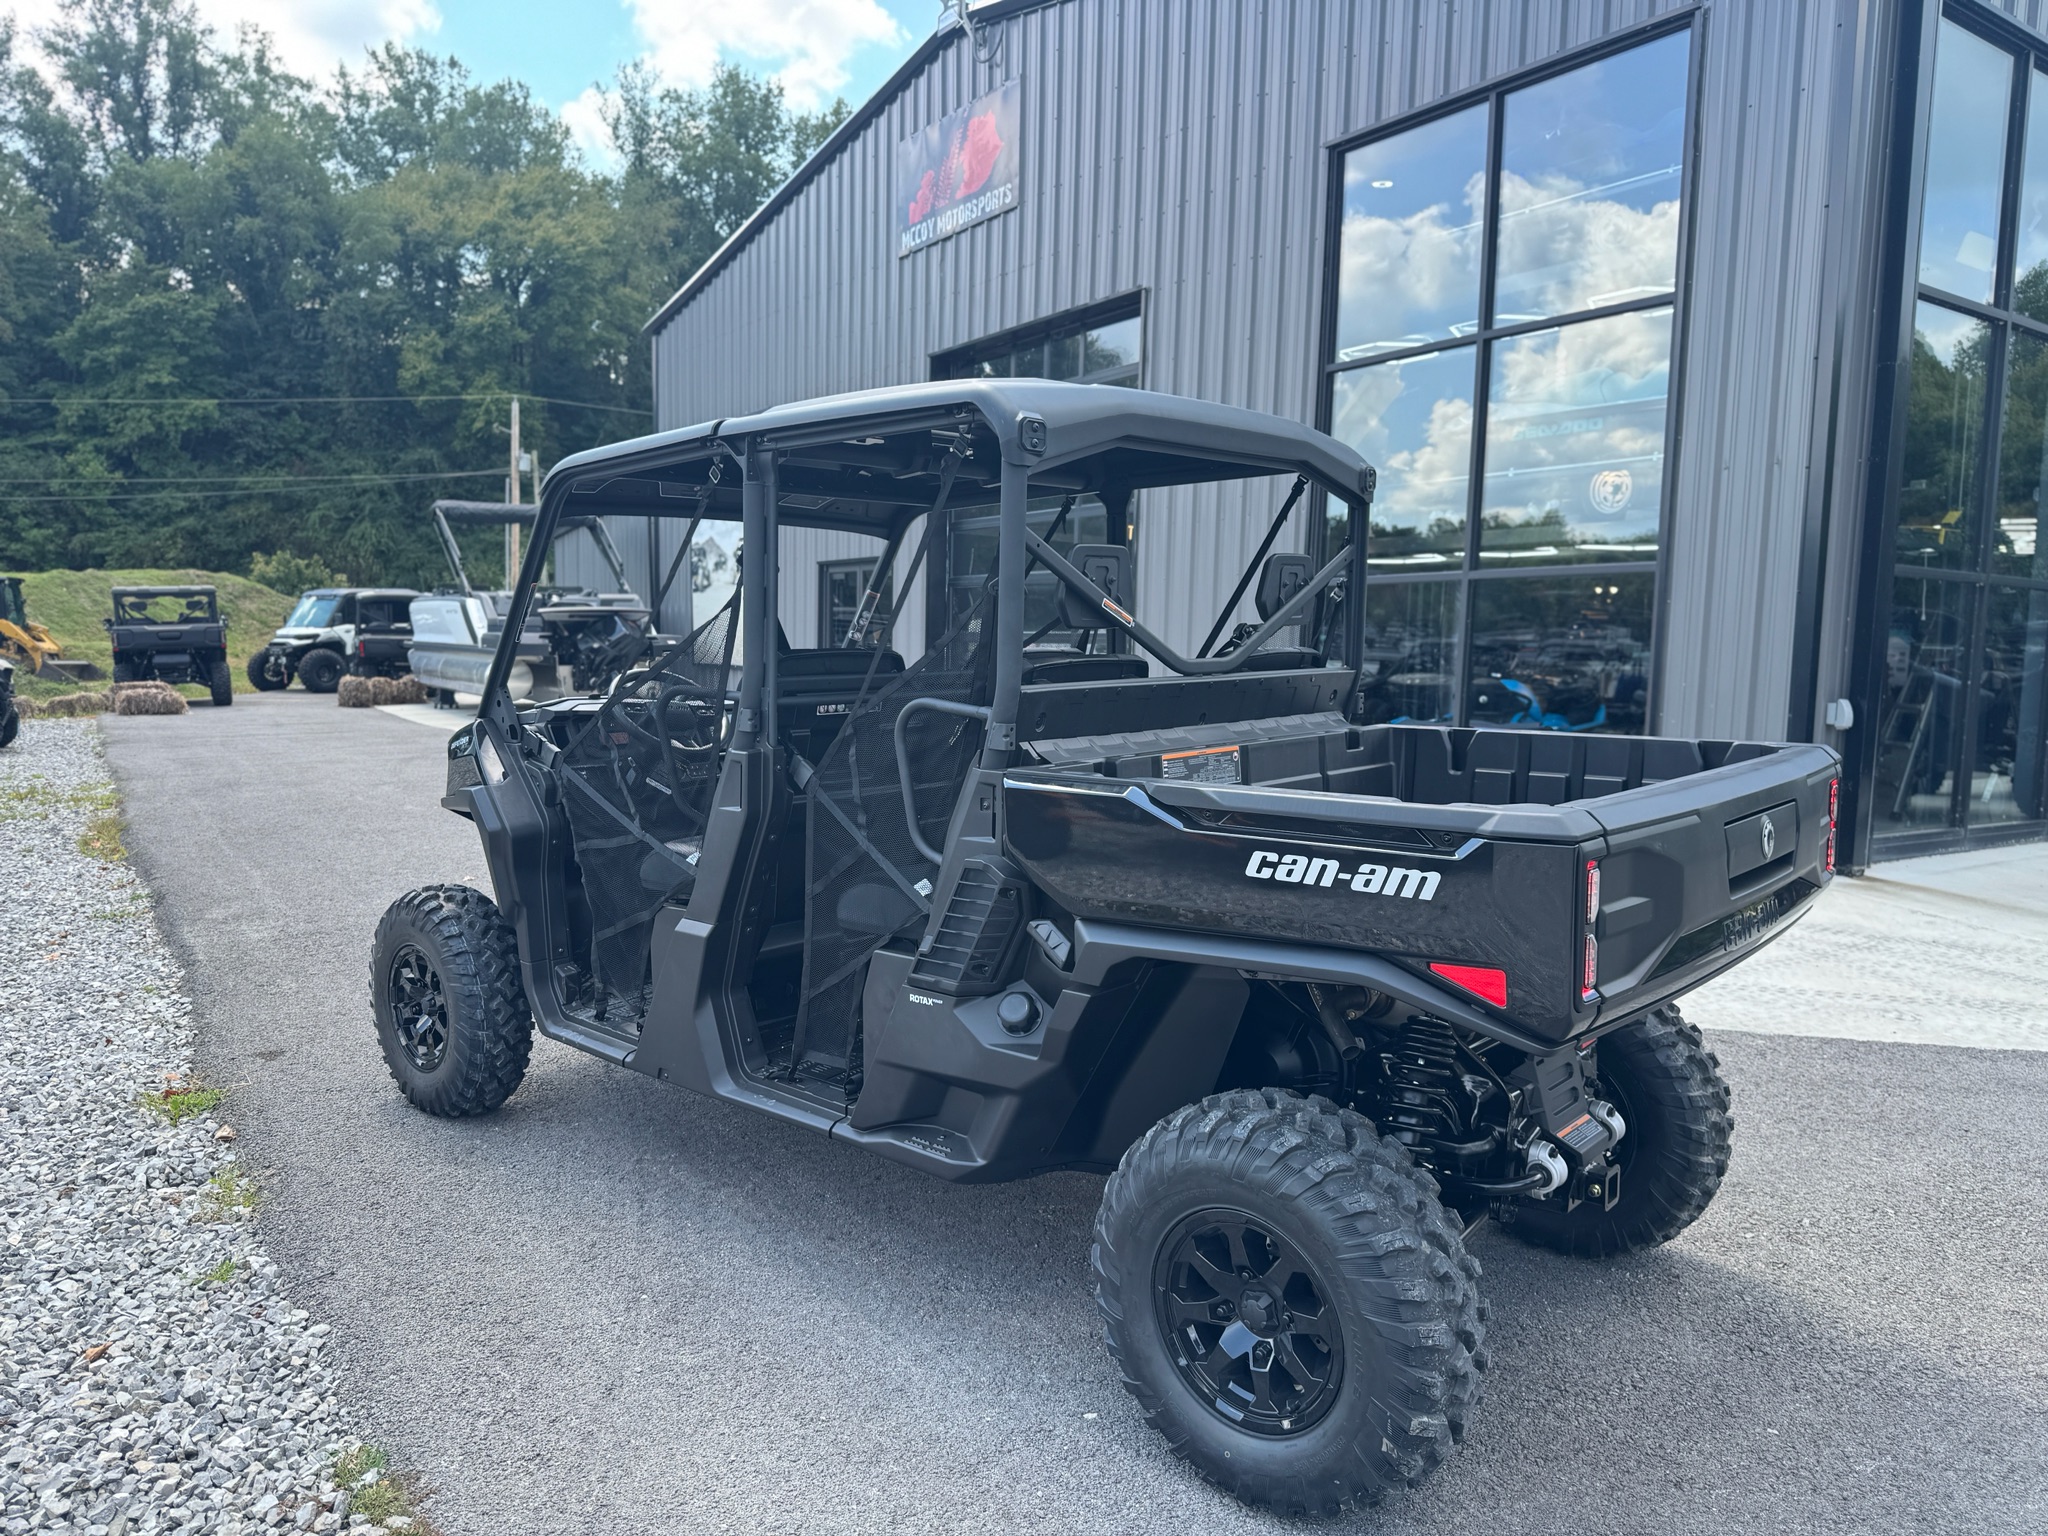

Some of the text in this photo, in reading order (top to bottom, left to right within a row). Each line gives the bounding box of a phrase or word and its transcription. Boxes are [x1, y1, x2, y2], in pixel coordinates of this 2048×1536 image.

[901, 183, 1012, 249] MCCOY MOTORSPORTS
[1245, 850, 1442, 901] can-am
[910, 993, 934, 1006] ROTAX
